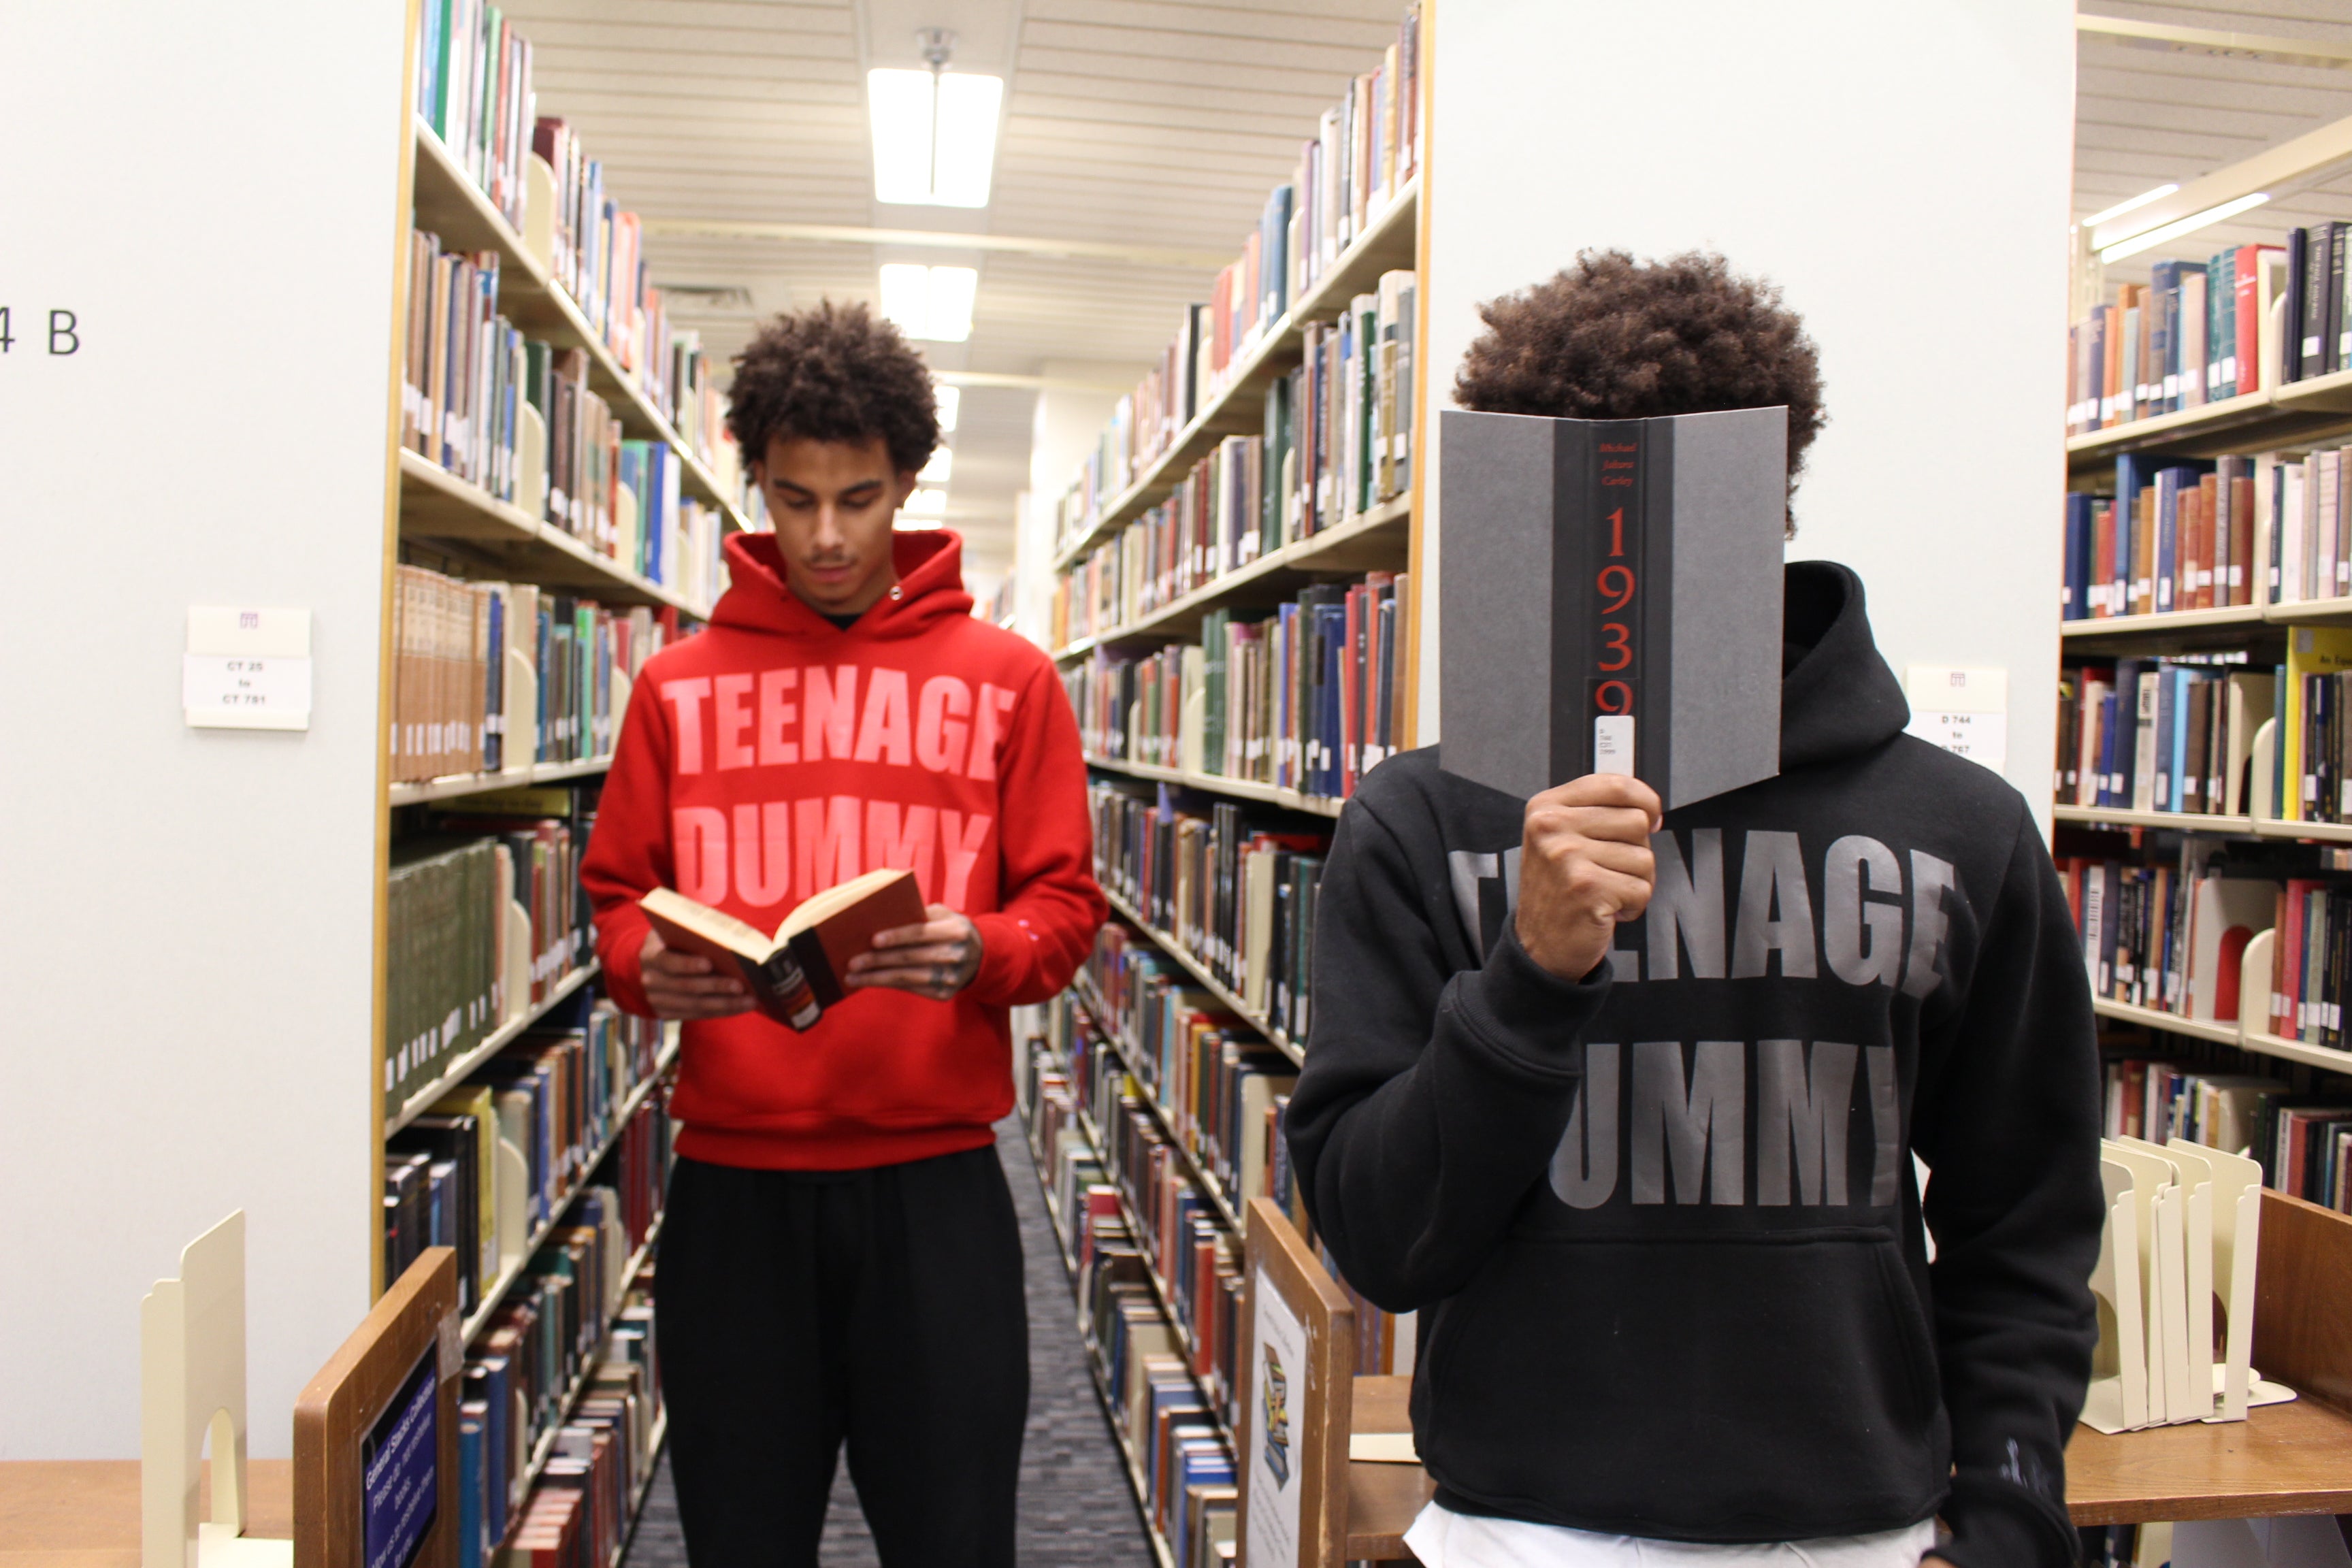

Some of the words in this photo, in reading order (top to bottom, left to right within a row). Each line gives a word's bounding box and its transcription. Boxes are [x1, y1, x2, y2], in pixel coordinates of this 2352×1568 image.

[49, 309, 80, 355] B
[227, 662, 243, 672] CT
[222, 694, 238, 704] CT
[661, 664, 1017, 781] TEENAGE
[1942, 715, 1949, 724] D
[672, 795, 993, 913] DUMMY
[1448, 828, 1955, 999] TNAGE
[1549, 1039, 1899, 1209] UMMY
[365, 1442, 391, 1490] General
